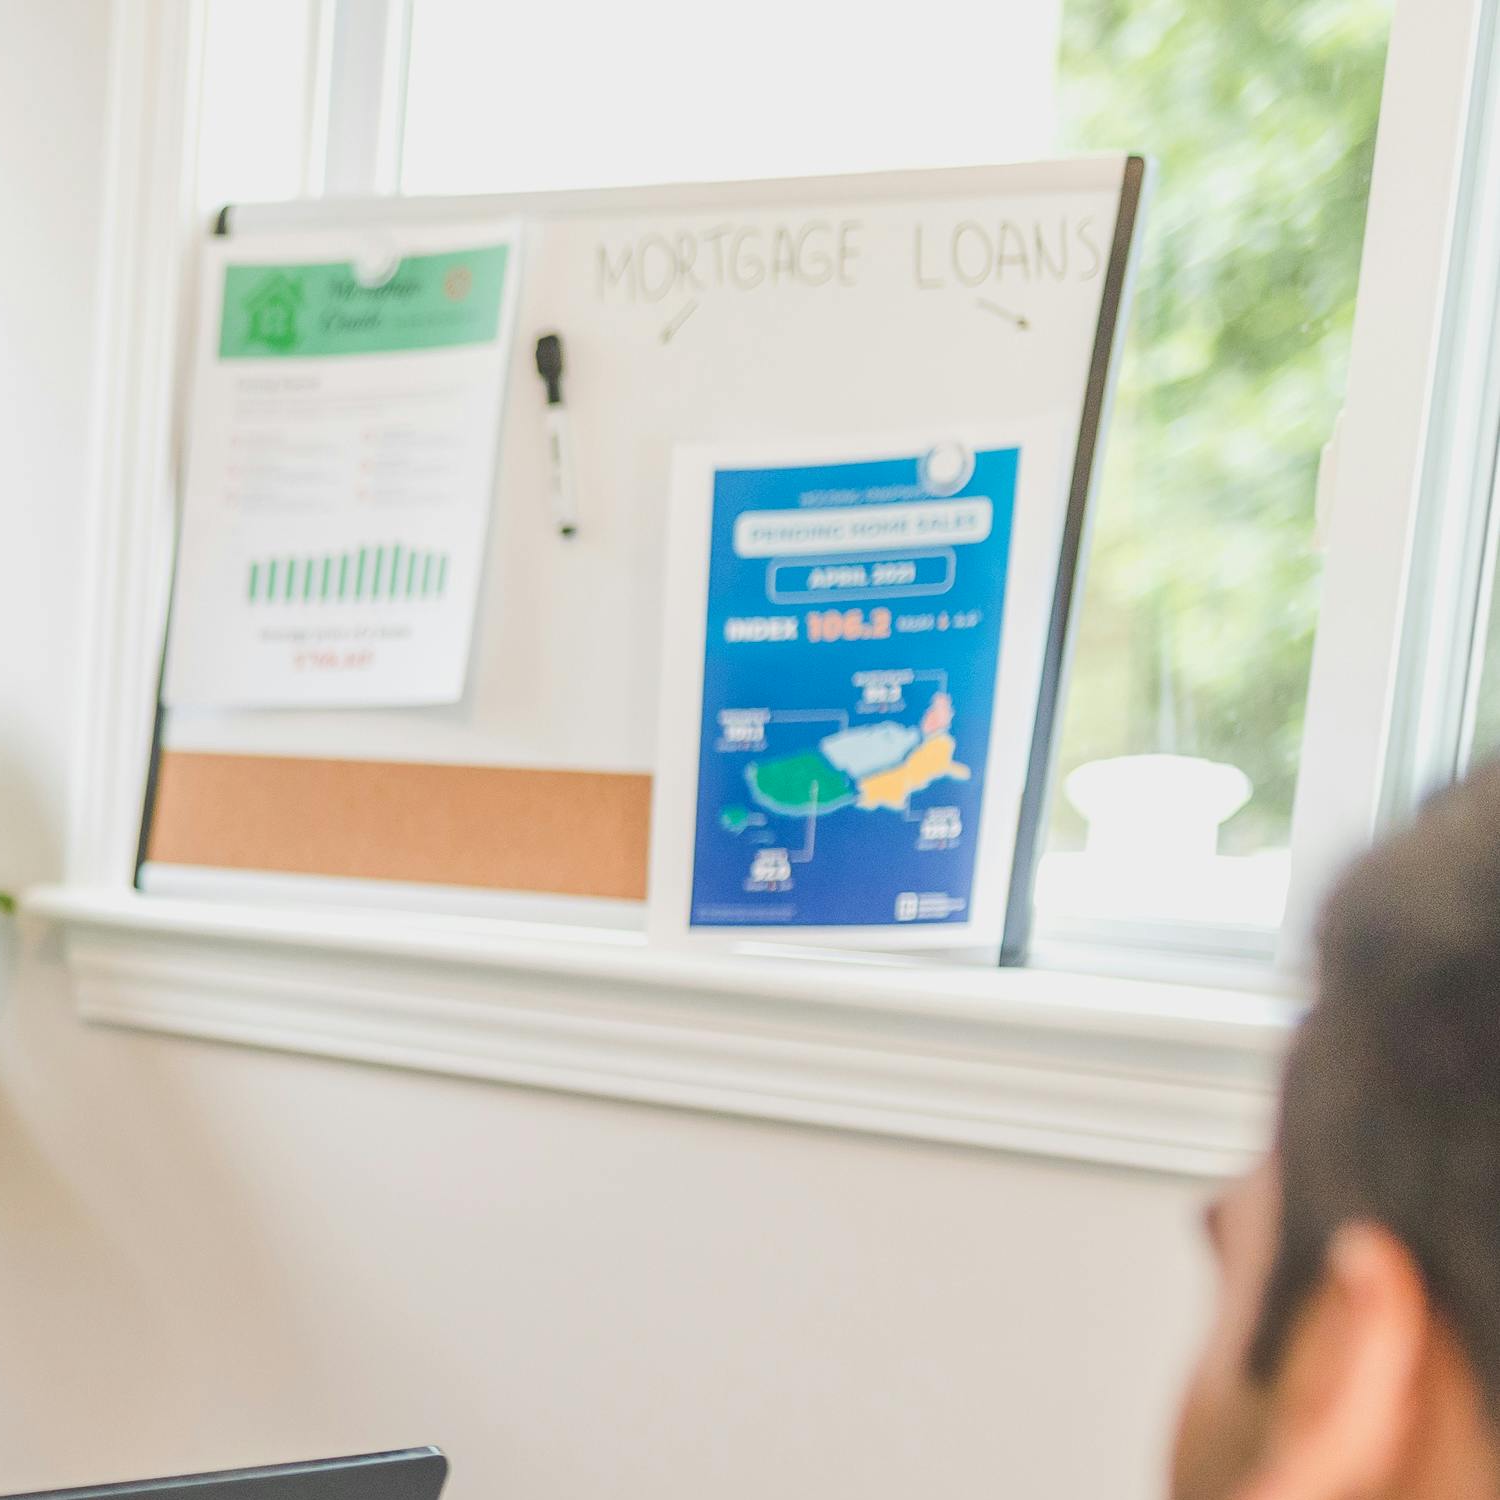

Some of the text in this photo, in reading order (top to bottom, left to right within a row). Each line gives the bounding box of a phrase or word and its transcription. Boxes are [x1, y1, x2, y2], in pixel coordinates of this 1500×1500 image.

[594, 215, 1102, 302] MORTGAGE LOANS
[724, 615, 798, 643] INDEX
[806, 606, 892, 644] 106.2
